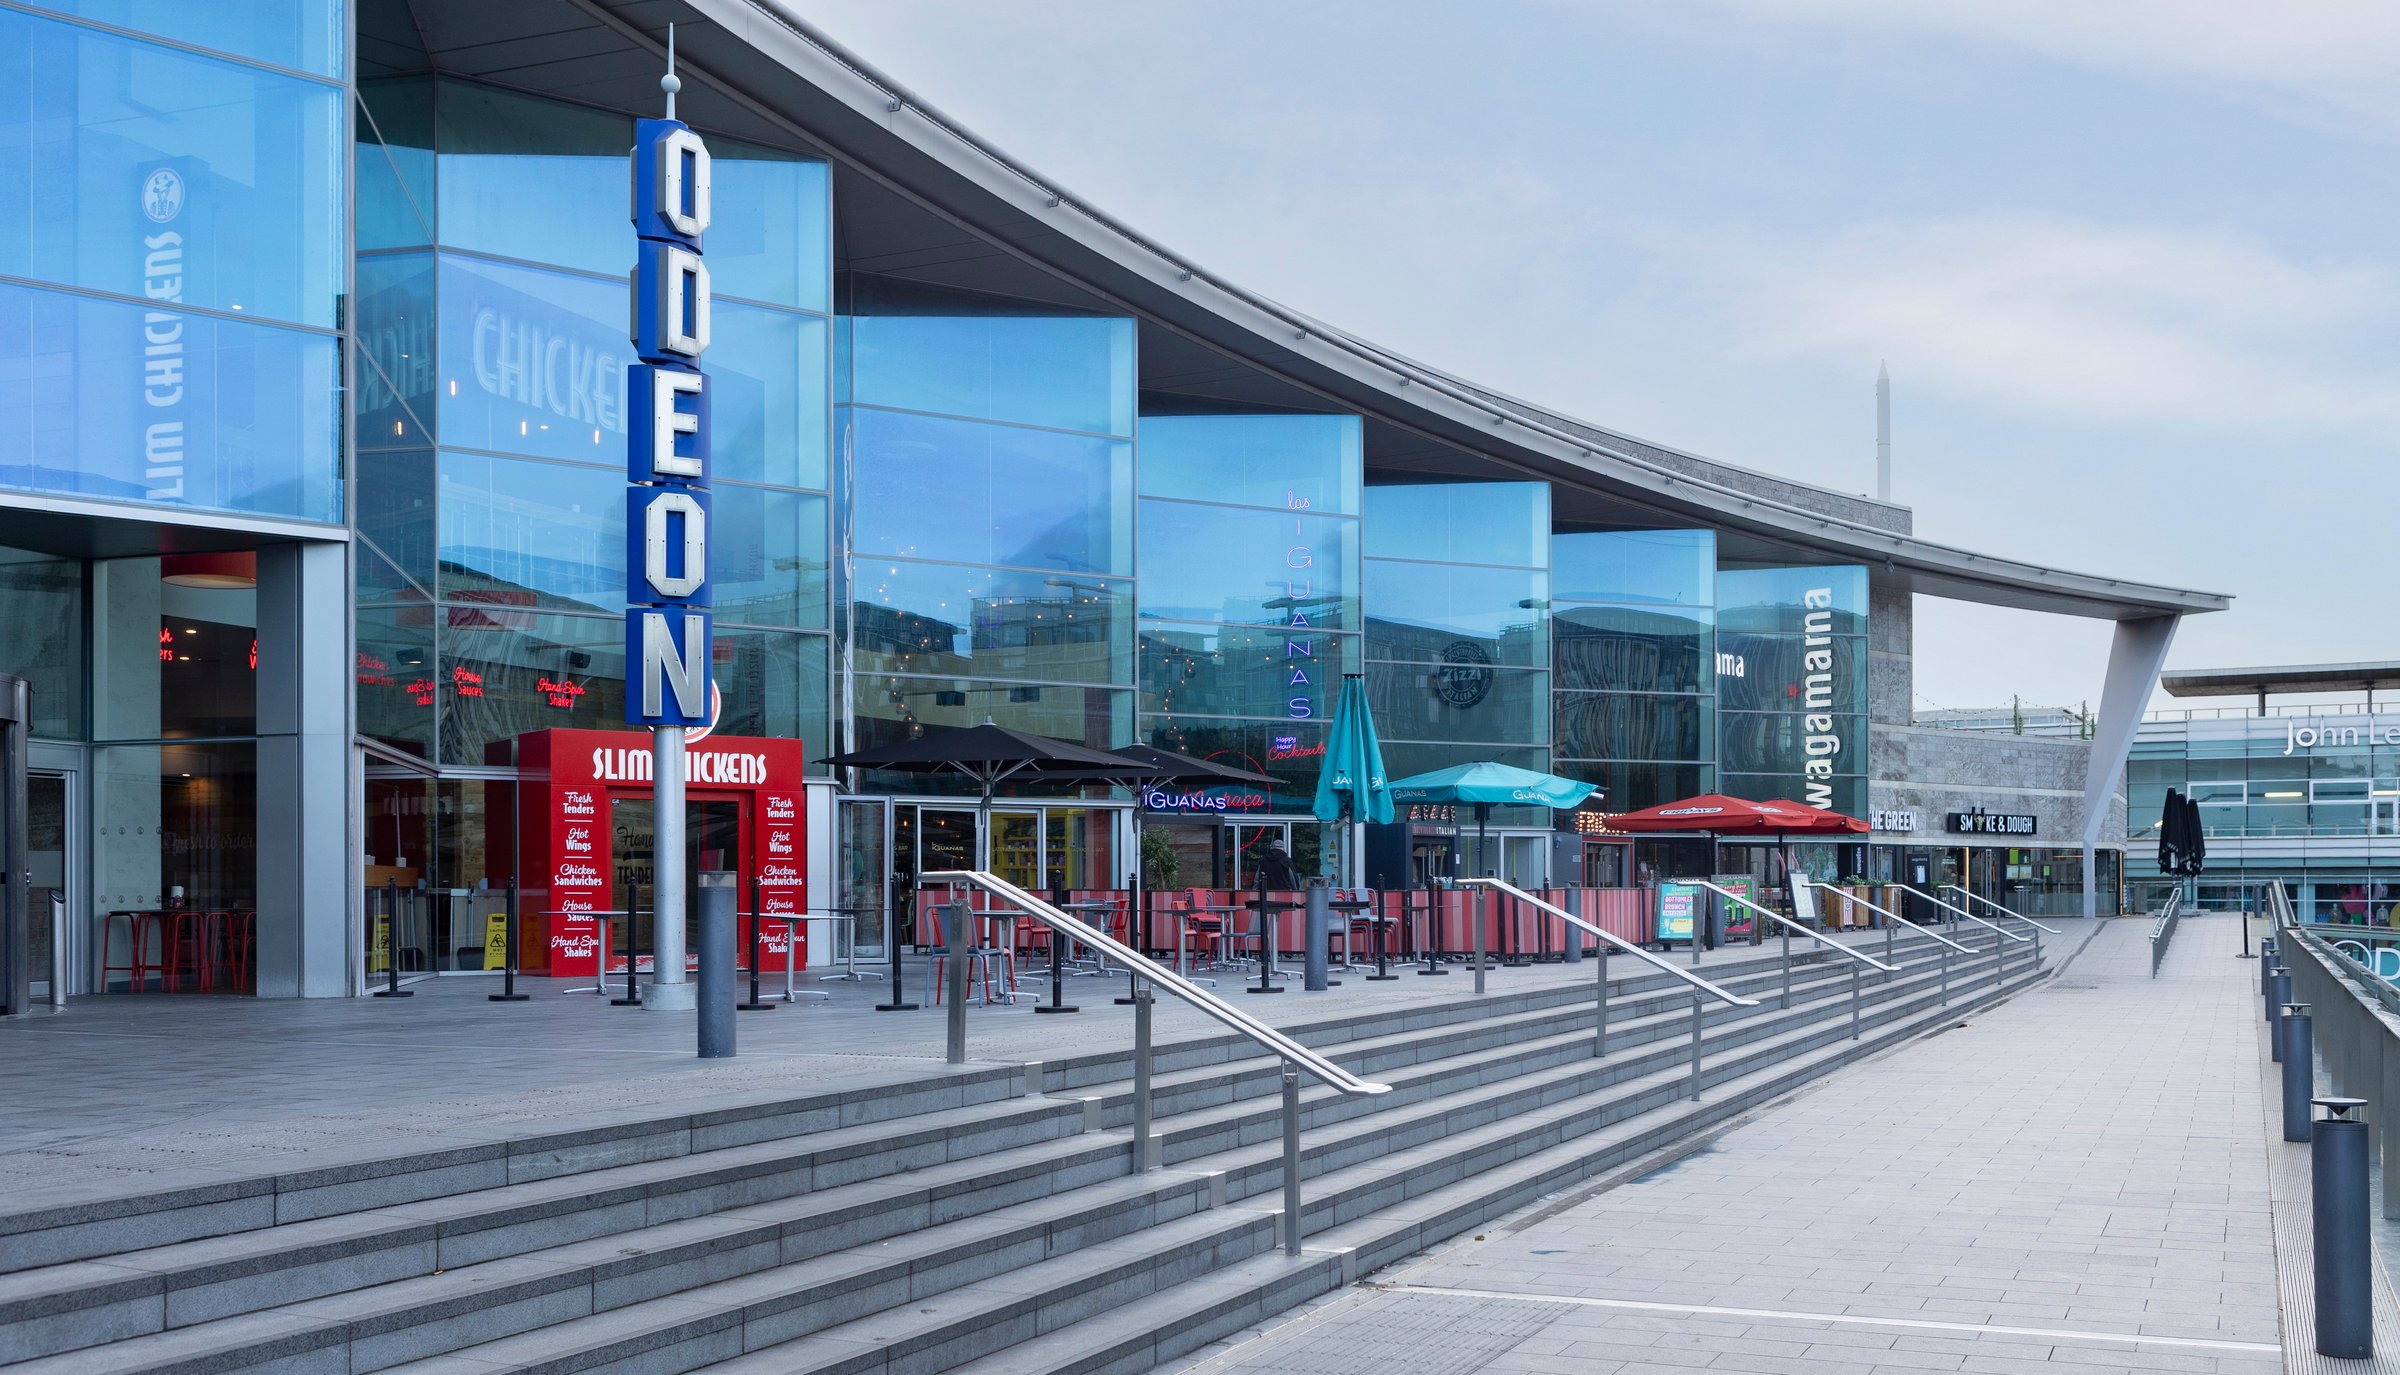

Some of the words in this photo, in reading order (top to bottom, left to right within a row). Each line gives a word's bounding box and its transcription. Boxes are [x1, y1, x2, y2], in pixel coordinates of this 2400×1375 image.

[144, 231, 183, 407] CHICKENS
[472, 307, 628, 433] CHICKE
[643, 129, 711, 718] ODEON
[1288, 490, 1310, 509] las
[1287, 519, 1312, 718] IGUANAS
[453, 666, 482, 683] House
[458, 681, 483, 697] Sauces
[537, 677, 563, 693] Hand
[563, 681, 586, 698] Spun
[549, 693, 574, 708] Shakes
[1804, 587, 1841, 810] wagamama
[1275, 736, 1297, 744] Happy
[2283, 718, 2359, 755] John
[1267, 741, 1327, 761] Cocktails
[592, 747, 653, 781] SLIM
[564, 791, 593, 804] Fresh
[768, 797, 793, 808] Fresh
[563, 803, 594, 814] Tenders
[766, 808, 795, 818] Tenders
[1436, 826, 1457, 835] ITALIAN
[1998, 816, 2005, 831] &
[2007, 816, 2033, 833] DOUGH
[568, 827, 589, 840] Hot
[771, 831, 790, 842] Hot
[565, 840, 592, 853] Wings
[769, 842, 793, 854] Wings
[560, 863, 597, 876] Chicken
[764, 864, 797, 876] Chicken
[554, 875, 603, 886] Sandwiches
[758, 875, 802, 886] Sandwiches
[562, 899, 593, 912] House
[766, 898, 794, 910] House
[551, 936, 579, 948] Hand
[580, 935, 599, 950] Spu
[564, 946, 592, 958] Shakes
